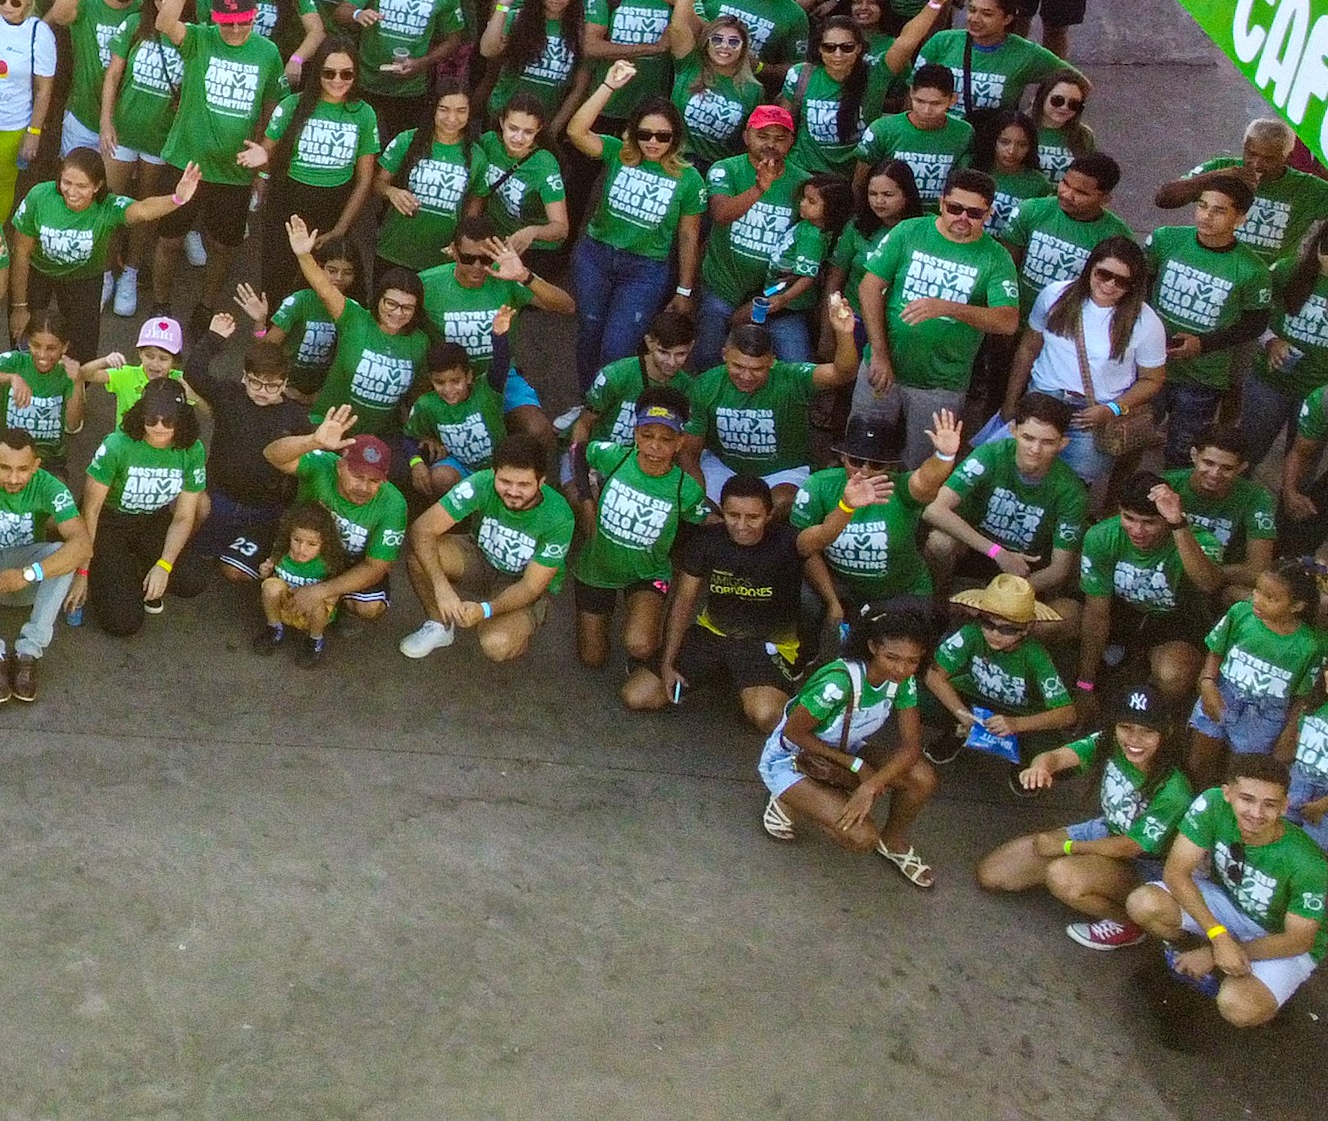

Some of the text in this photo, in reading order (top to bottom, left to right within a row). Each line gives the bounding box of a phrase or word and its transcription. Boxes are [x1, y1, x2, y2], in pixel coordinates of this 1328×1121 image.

[205, 80, 232, 98] PELO
[298, 140, 330, 154] PELO
[609, 186, 642, 207] PELO
[904, 276, 939, 298] PELO
[1159, 285, 1192, 308] PELO
[601, 505, 632, 529] PELO
[229, 537, 259, 556] 23
